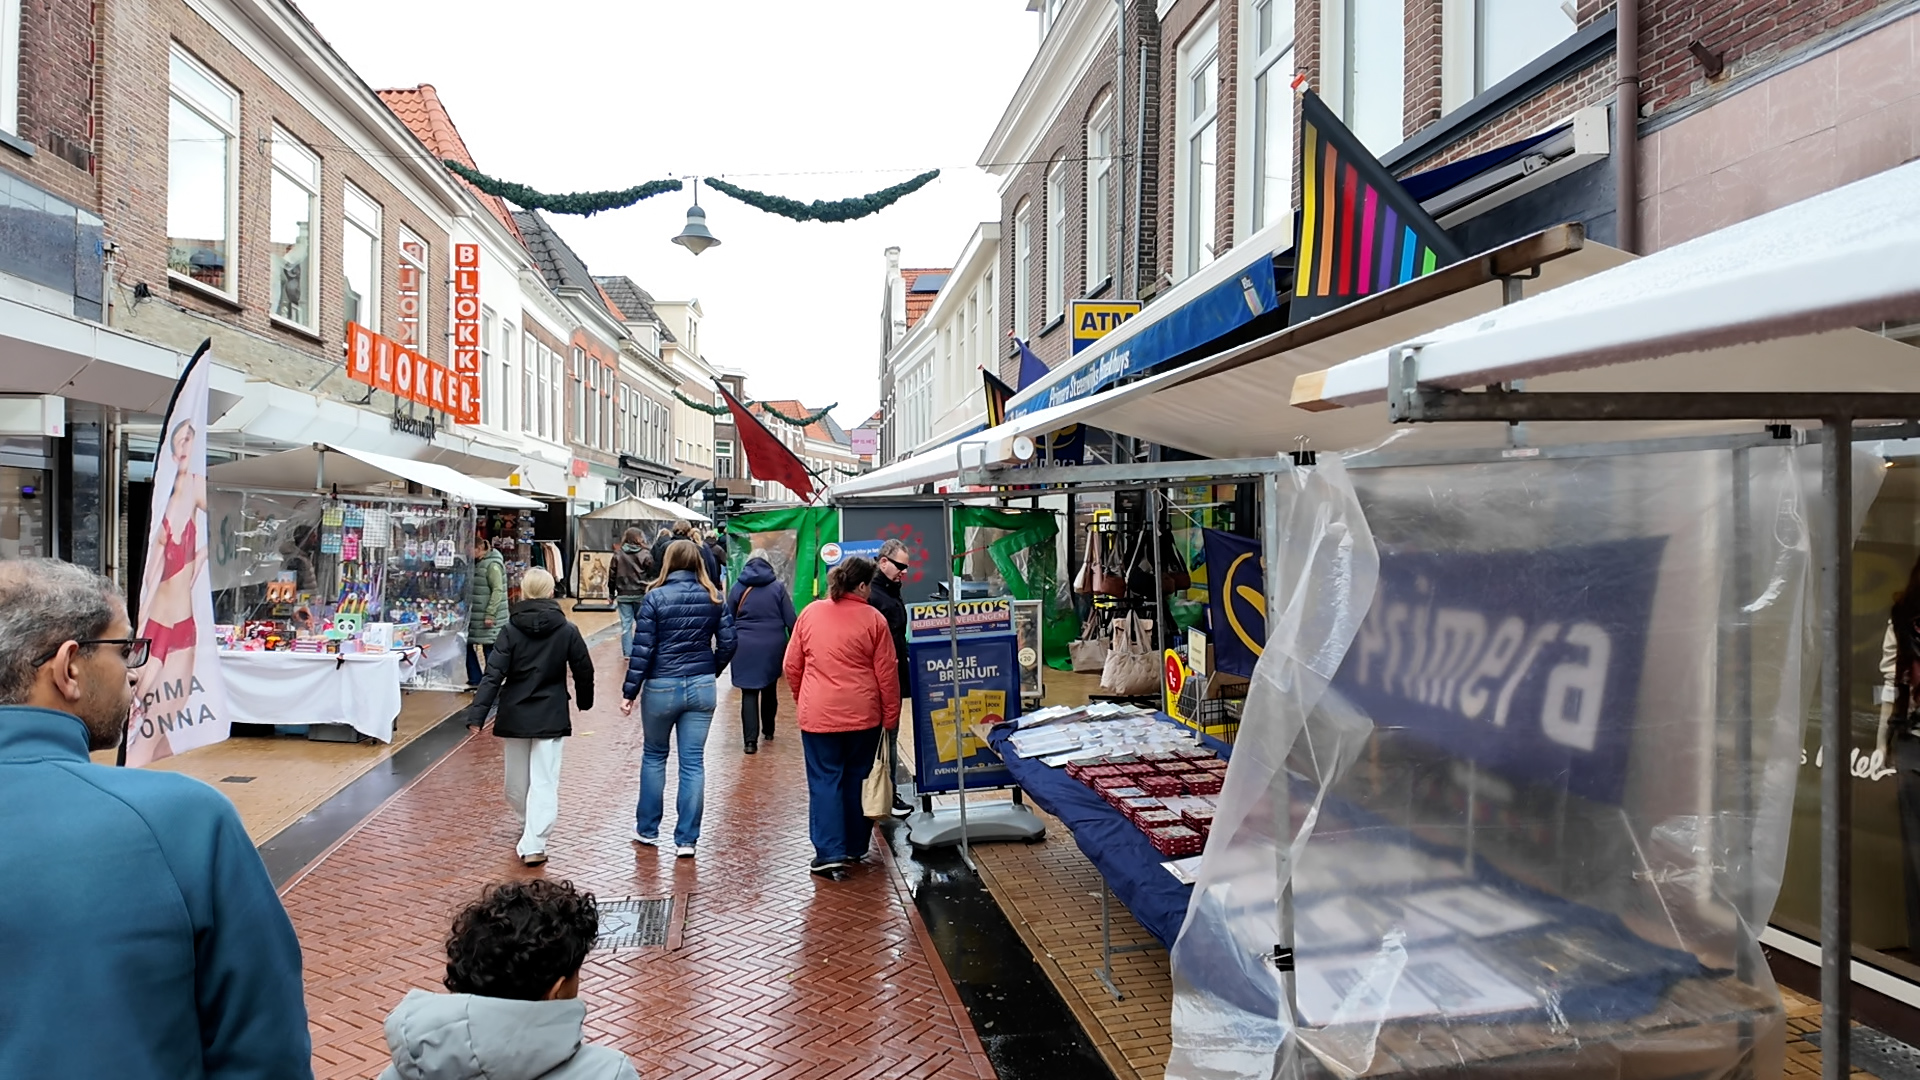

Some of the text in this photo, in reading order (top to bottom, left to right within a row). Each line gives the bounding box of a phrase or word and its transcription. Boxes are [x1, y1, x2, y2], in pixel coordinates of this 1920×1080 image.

[1080, 312, 1134, 330] ATM
[355, 332, 473, 414] BLOKKER
[913, 619, 951, 629] RIJBEWIJ
[965, 656, 978, 667] JE
[939, 665, 1000, 681] BREIN UIT.
